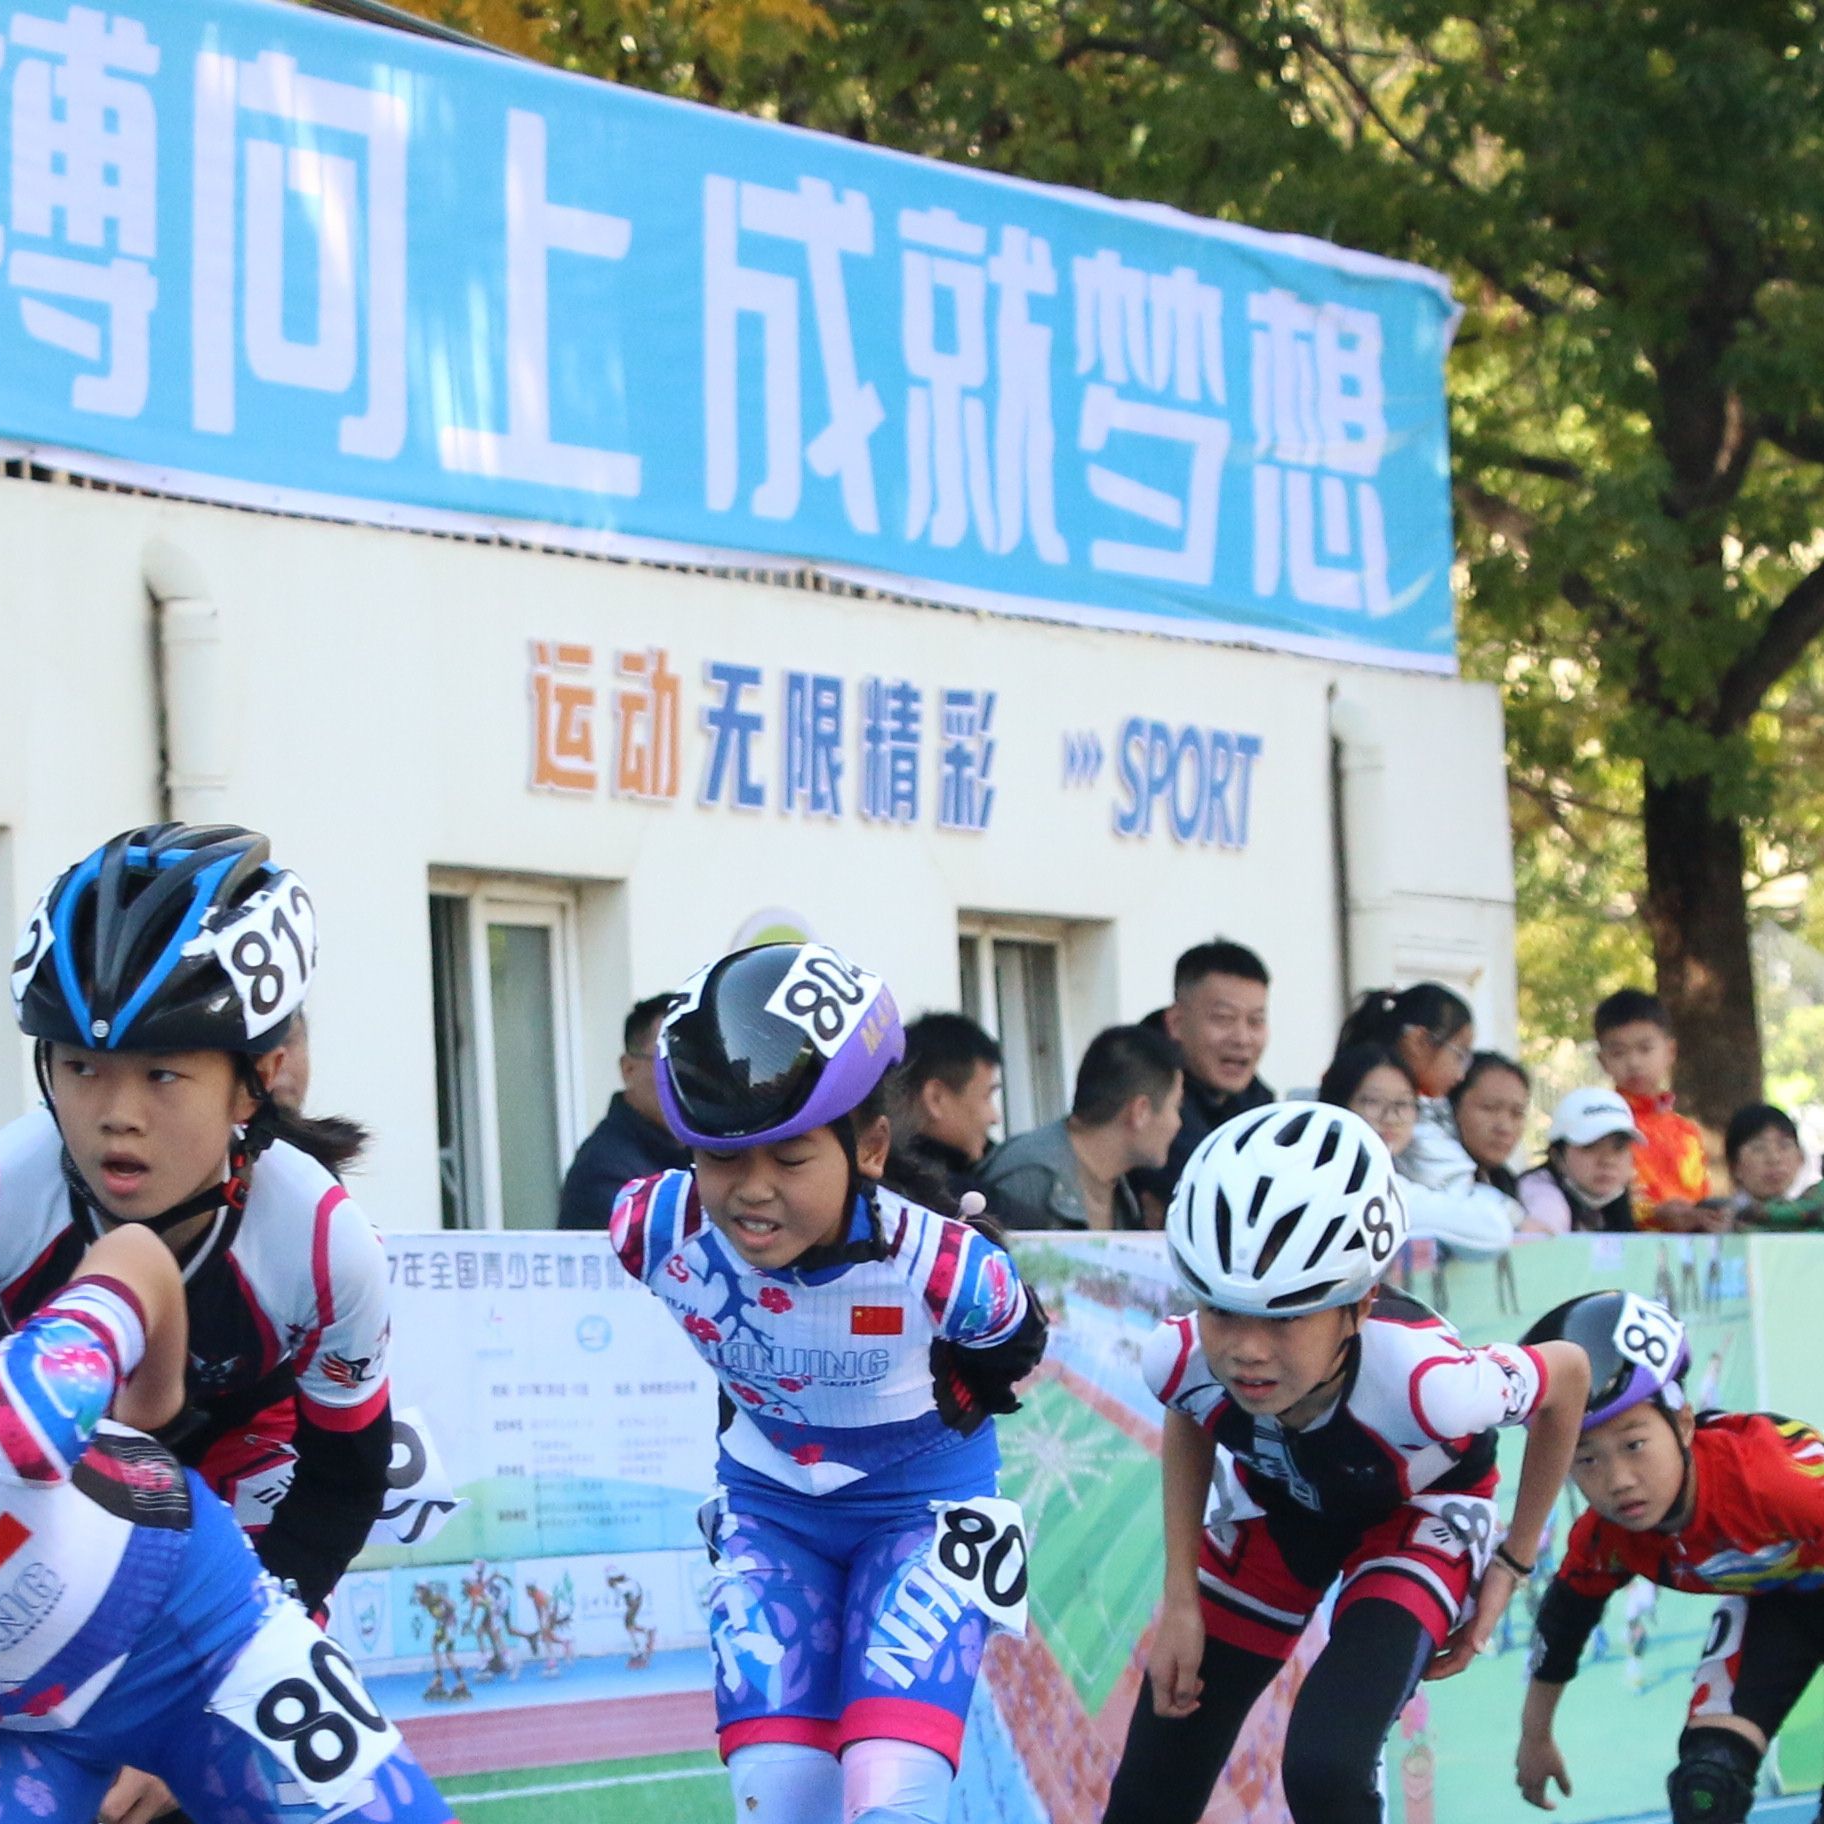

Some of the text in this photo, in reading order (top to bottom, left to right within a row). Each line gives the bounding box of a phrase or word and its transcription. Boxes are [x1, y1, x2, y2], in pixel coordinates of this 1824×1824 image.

[701, 174, 1396, 617] 成就梦想
[530, 641, 1262, 848] 运动无限精彩 SPORT
[939, 1507, 1028, 1608] 80
[256, 1640, 387, 1783] 80
